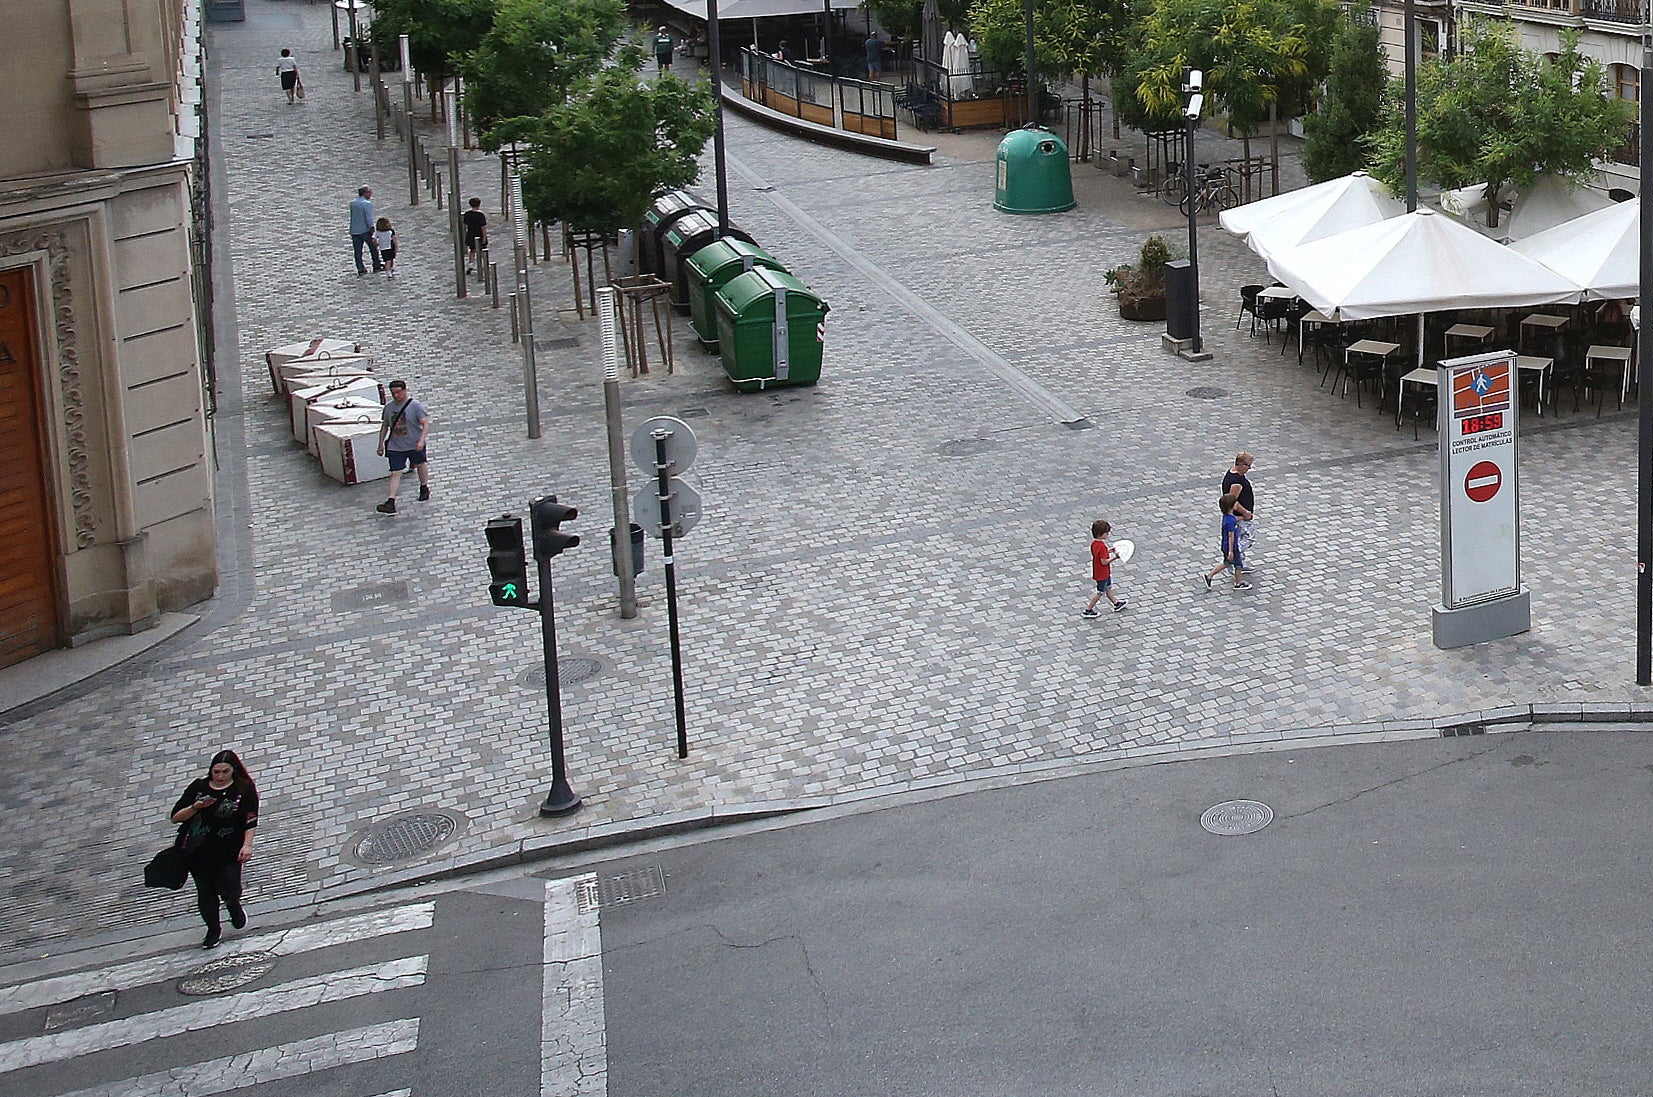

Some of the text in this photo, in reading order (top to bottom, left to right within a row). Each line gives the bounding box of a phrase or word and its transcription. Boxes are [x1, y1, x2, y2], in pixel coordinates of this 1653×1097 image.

[1462, 414, 1502, 434] 18:59
[1452, 431, 1512, 447] CONTROL AUTOMÁTICO
[1452, 445, 1473, 455] LECTOR
